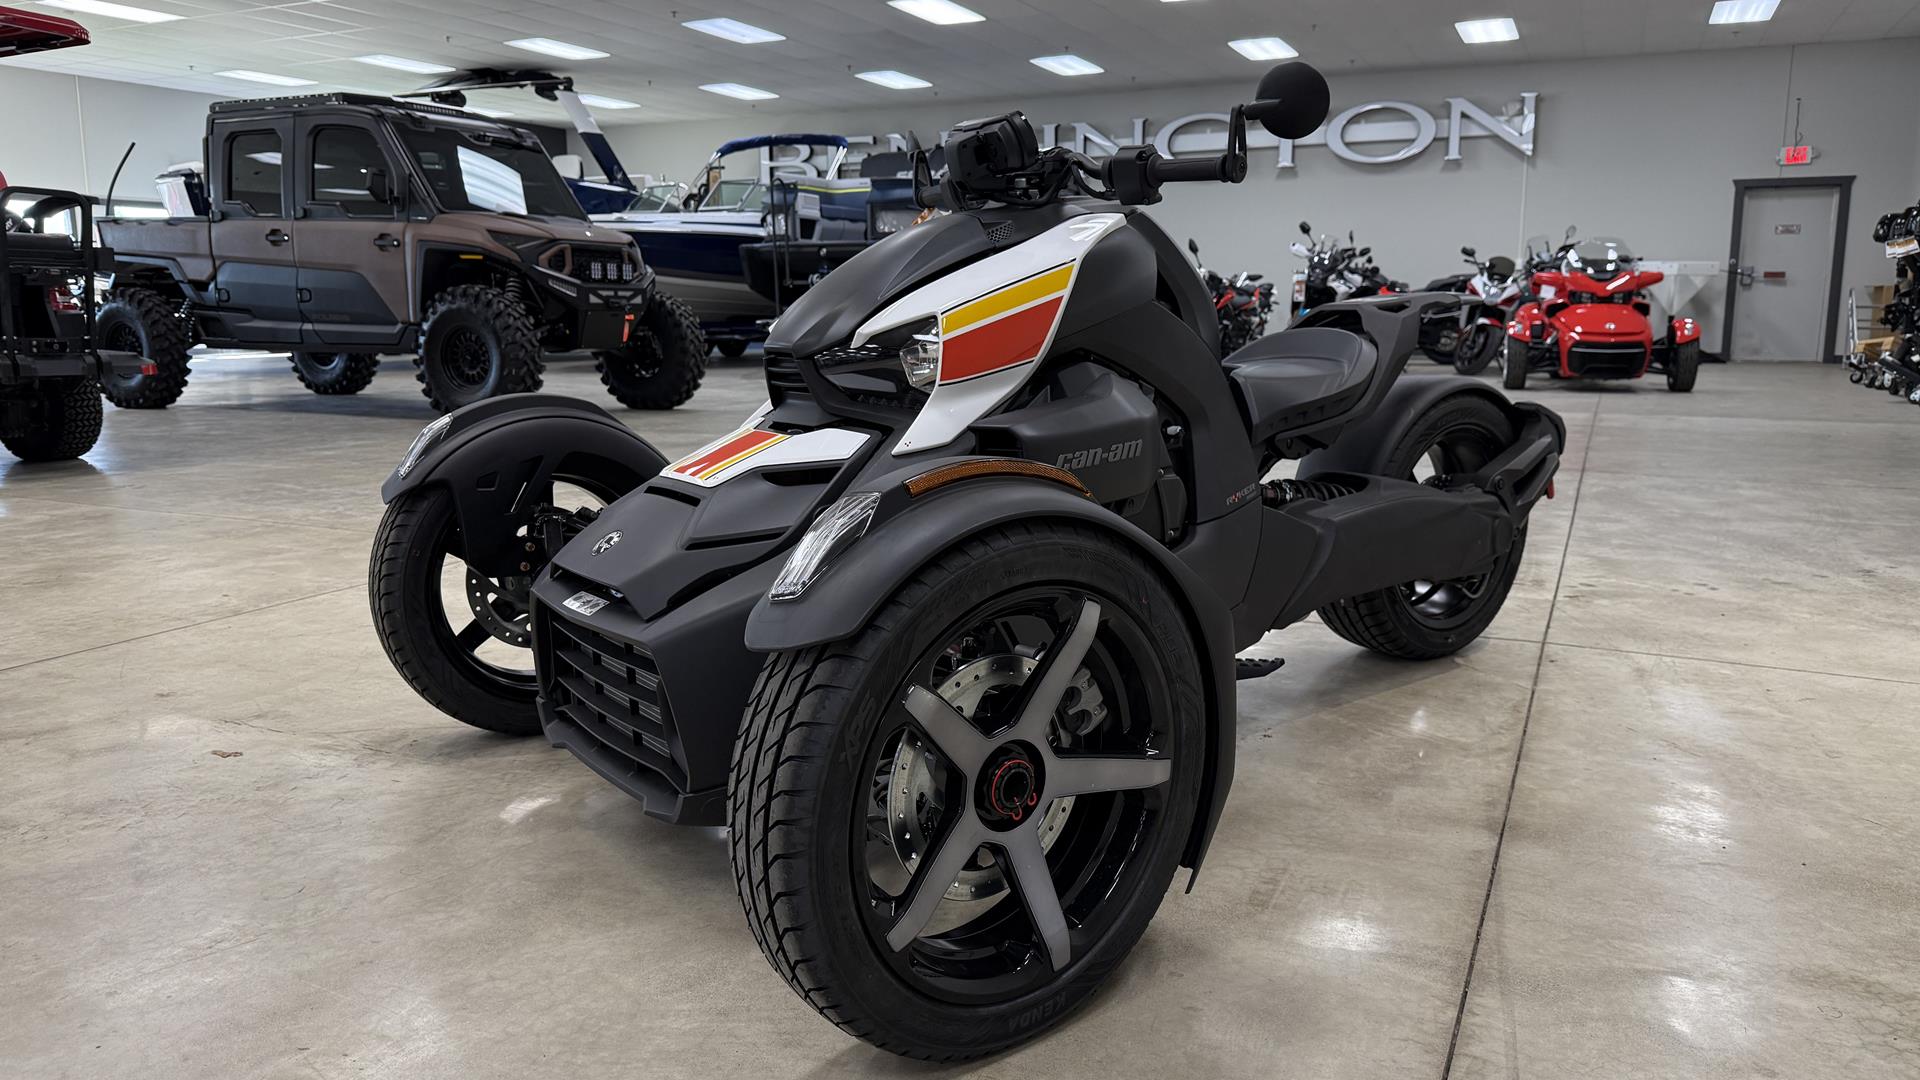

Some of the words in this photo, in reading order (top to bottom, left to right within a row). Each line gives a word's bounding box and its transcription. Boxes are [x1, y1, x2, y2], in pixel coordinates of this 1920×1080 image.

[759, 92, 1538, 186] BEINON
[1055, 438, 1143, 471] can-am
[1008, 991, 1067, 1033] KENDA
